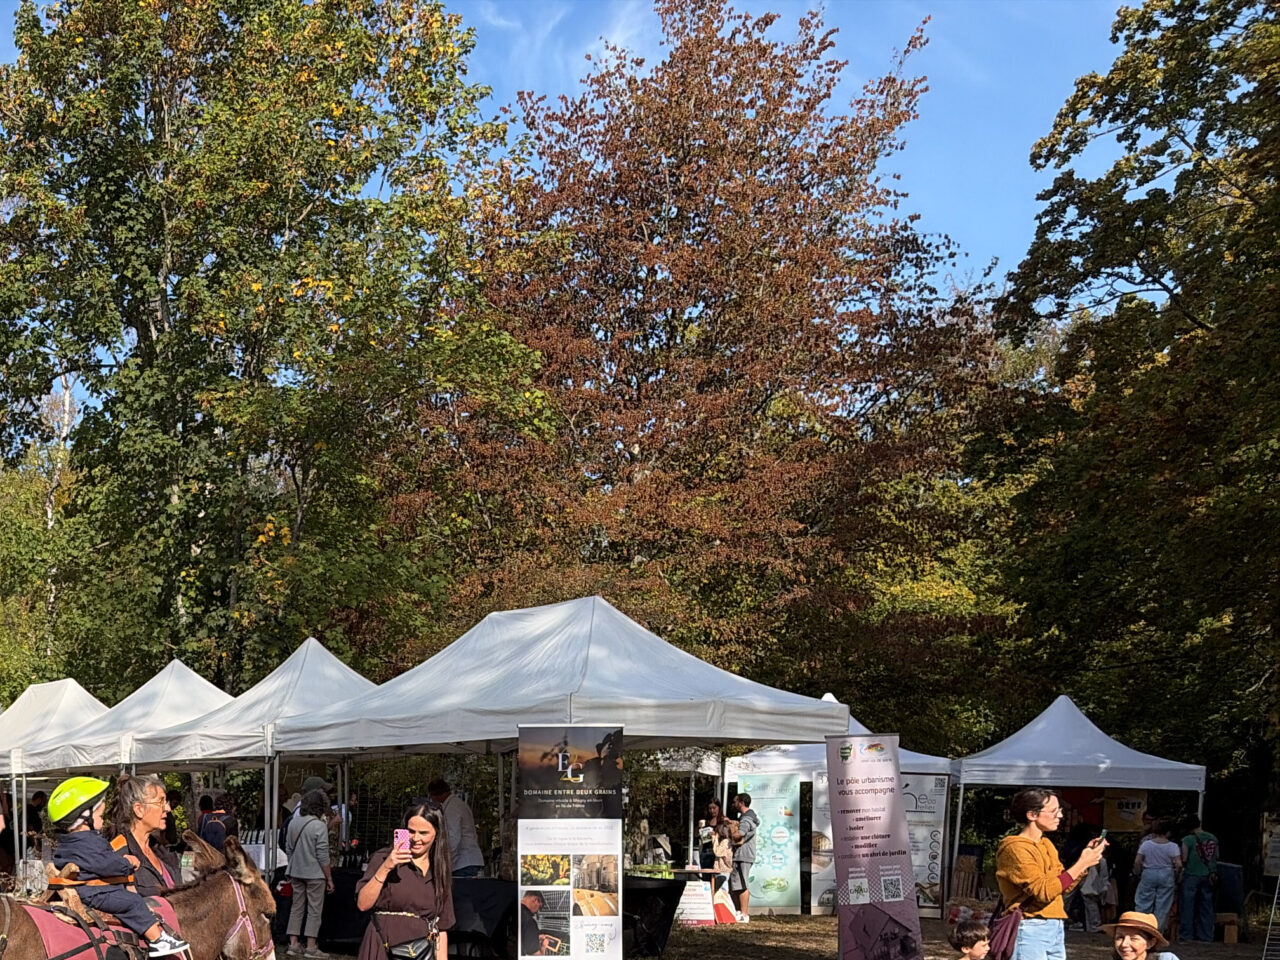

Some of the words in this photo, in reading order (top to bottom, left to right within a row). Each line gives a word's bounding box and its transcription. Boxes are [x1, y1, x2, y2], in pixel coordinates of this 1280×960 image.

[846, 777, 860, 785] pôle
[861, 776, 895, 784] urbanisme
[855, 788, 895, 796] accompagne
[889, 849, 907, 857] jardin
